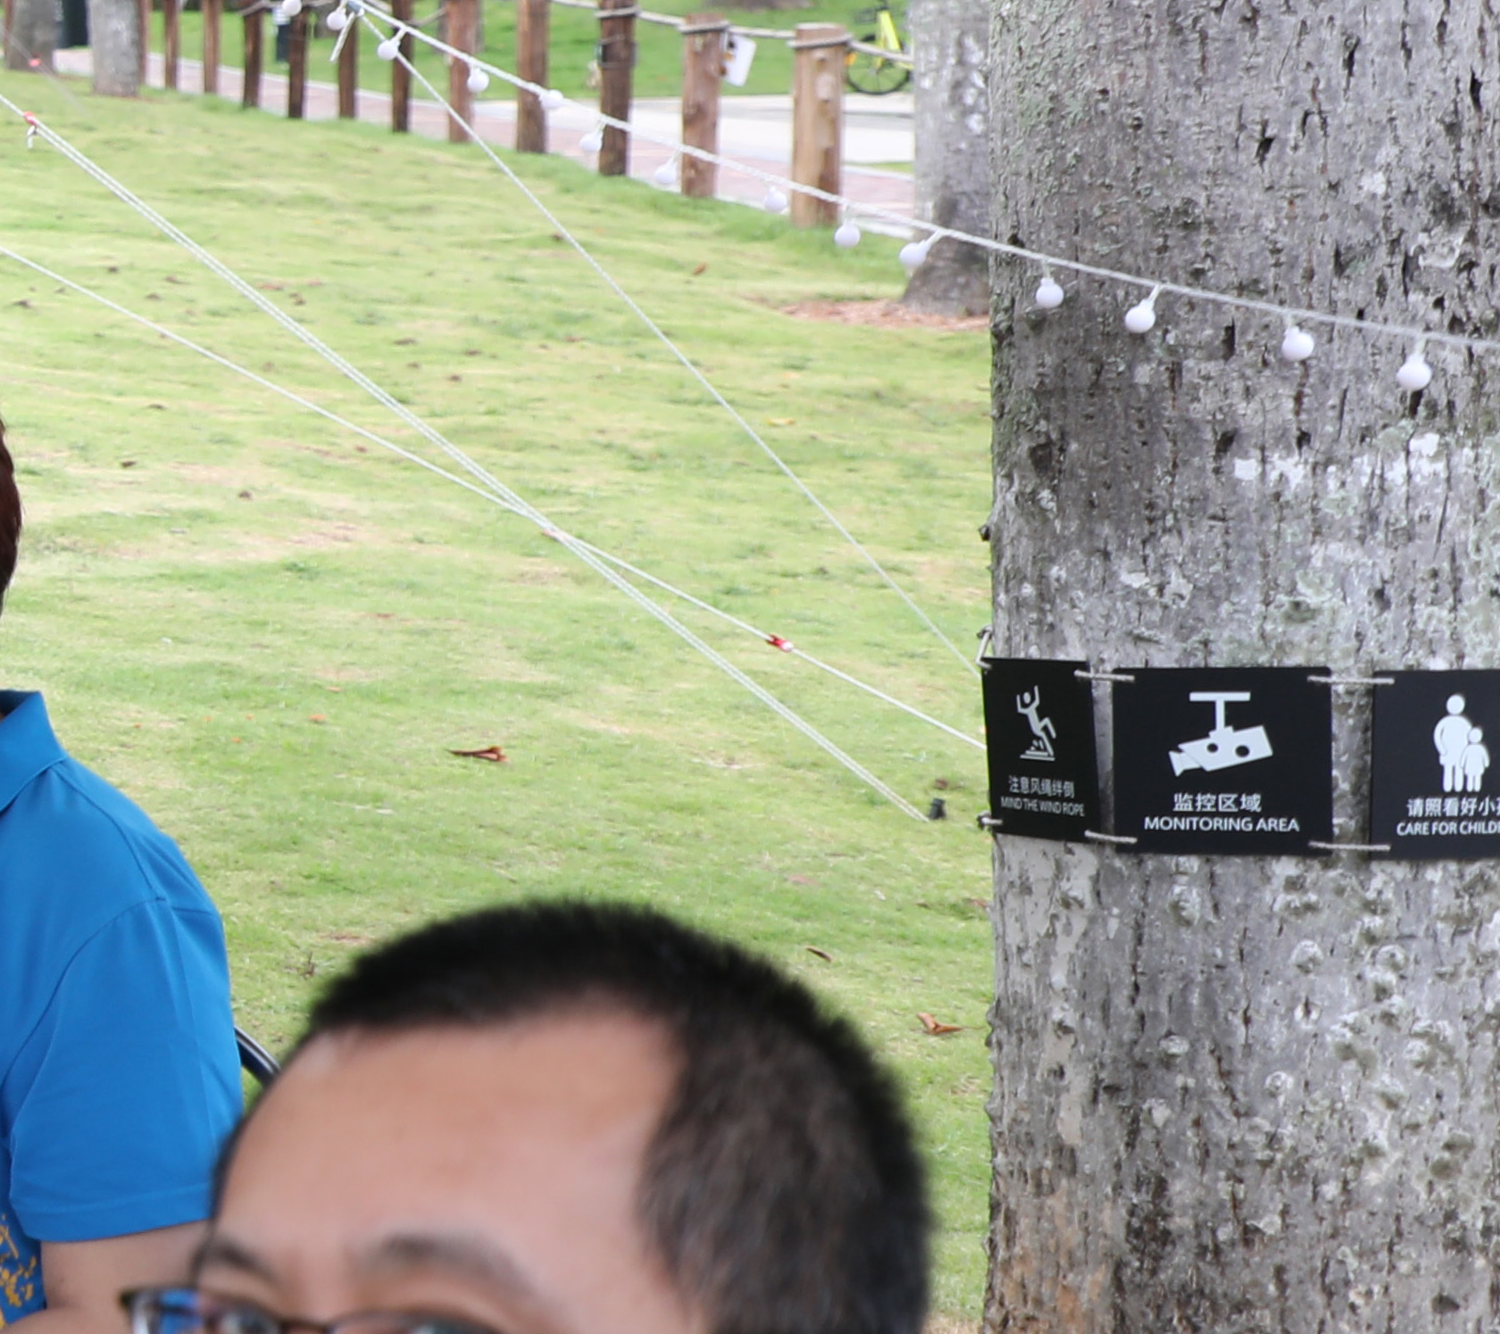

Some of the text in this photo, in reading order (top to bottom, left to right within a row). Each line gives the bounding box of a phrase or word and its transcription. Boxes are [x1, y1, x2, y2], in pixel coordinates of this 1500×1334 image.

[1001, 795, 1085, 817] MIND THE WIND ROPE
[1172, 793, 1262, 813] 监控区域
[1407, 796, 1500, 817] 请照看好小
[1144, 816, 1300, 832] MONITORING AREA
[1396, 820, 1430, 836] CARE
[1432, 820, 1458, 835] FOR
